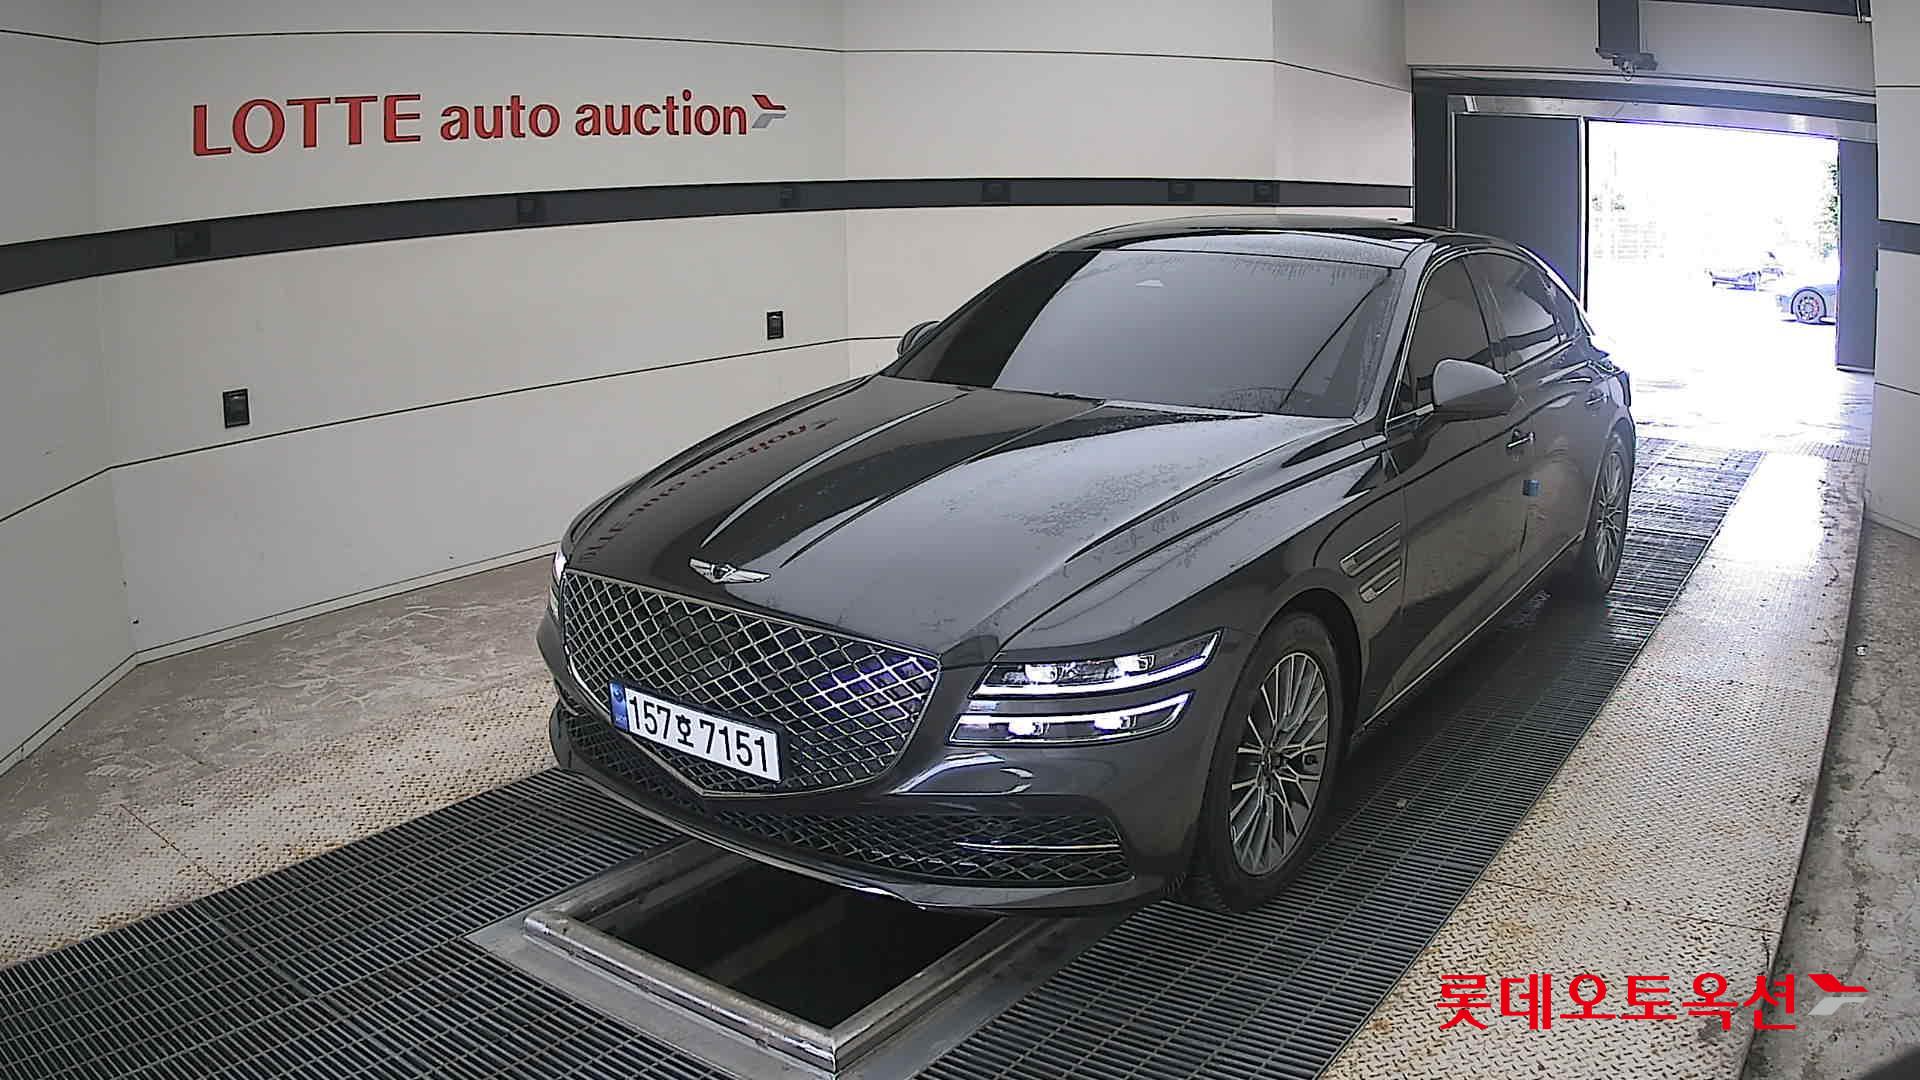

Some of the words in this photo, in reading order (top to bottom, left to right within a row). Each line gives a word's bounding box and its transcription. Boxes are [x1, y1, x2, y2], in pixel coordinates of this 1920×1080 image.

[192, 94, 421, 156] LOTTE
[440, 96, 560, 141] auto
[575, 89, 748, 137] auction
[629, 695, 694, 748] 157호
[699, 719, 768, 773] 7151
